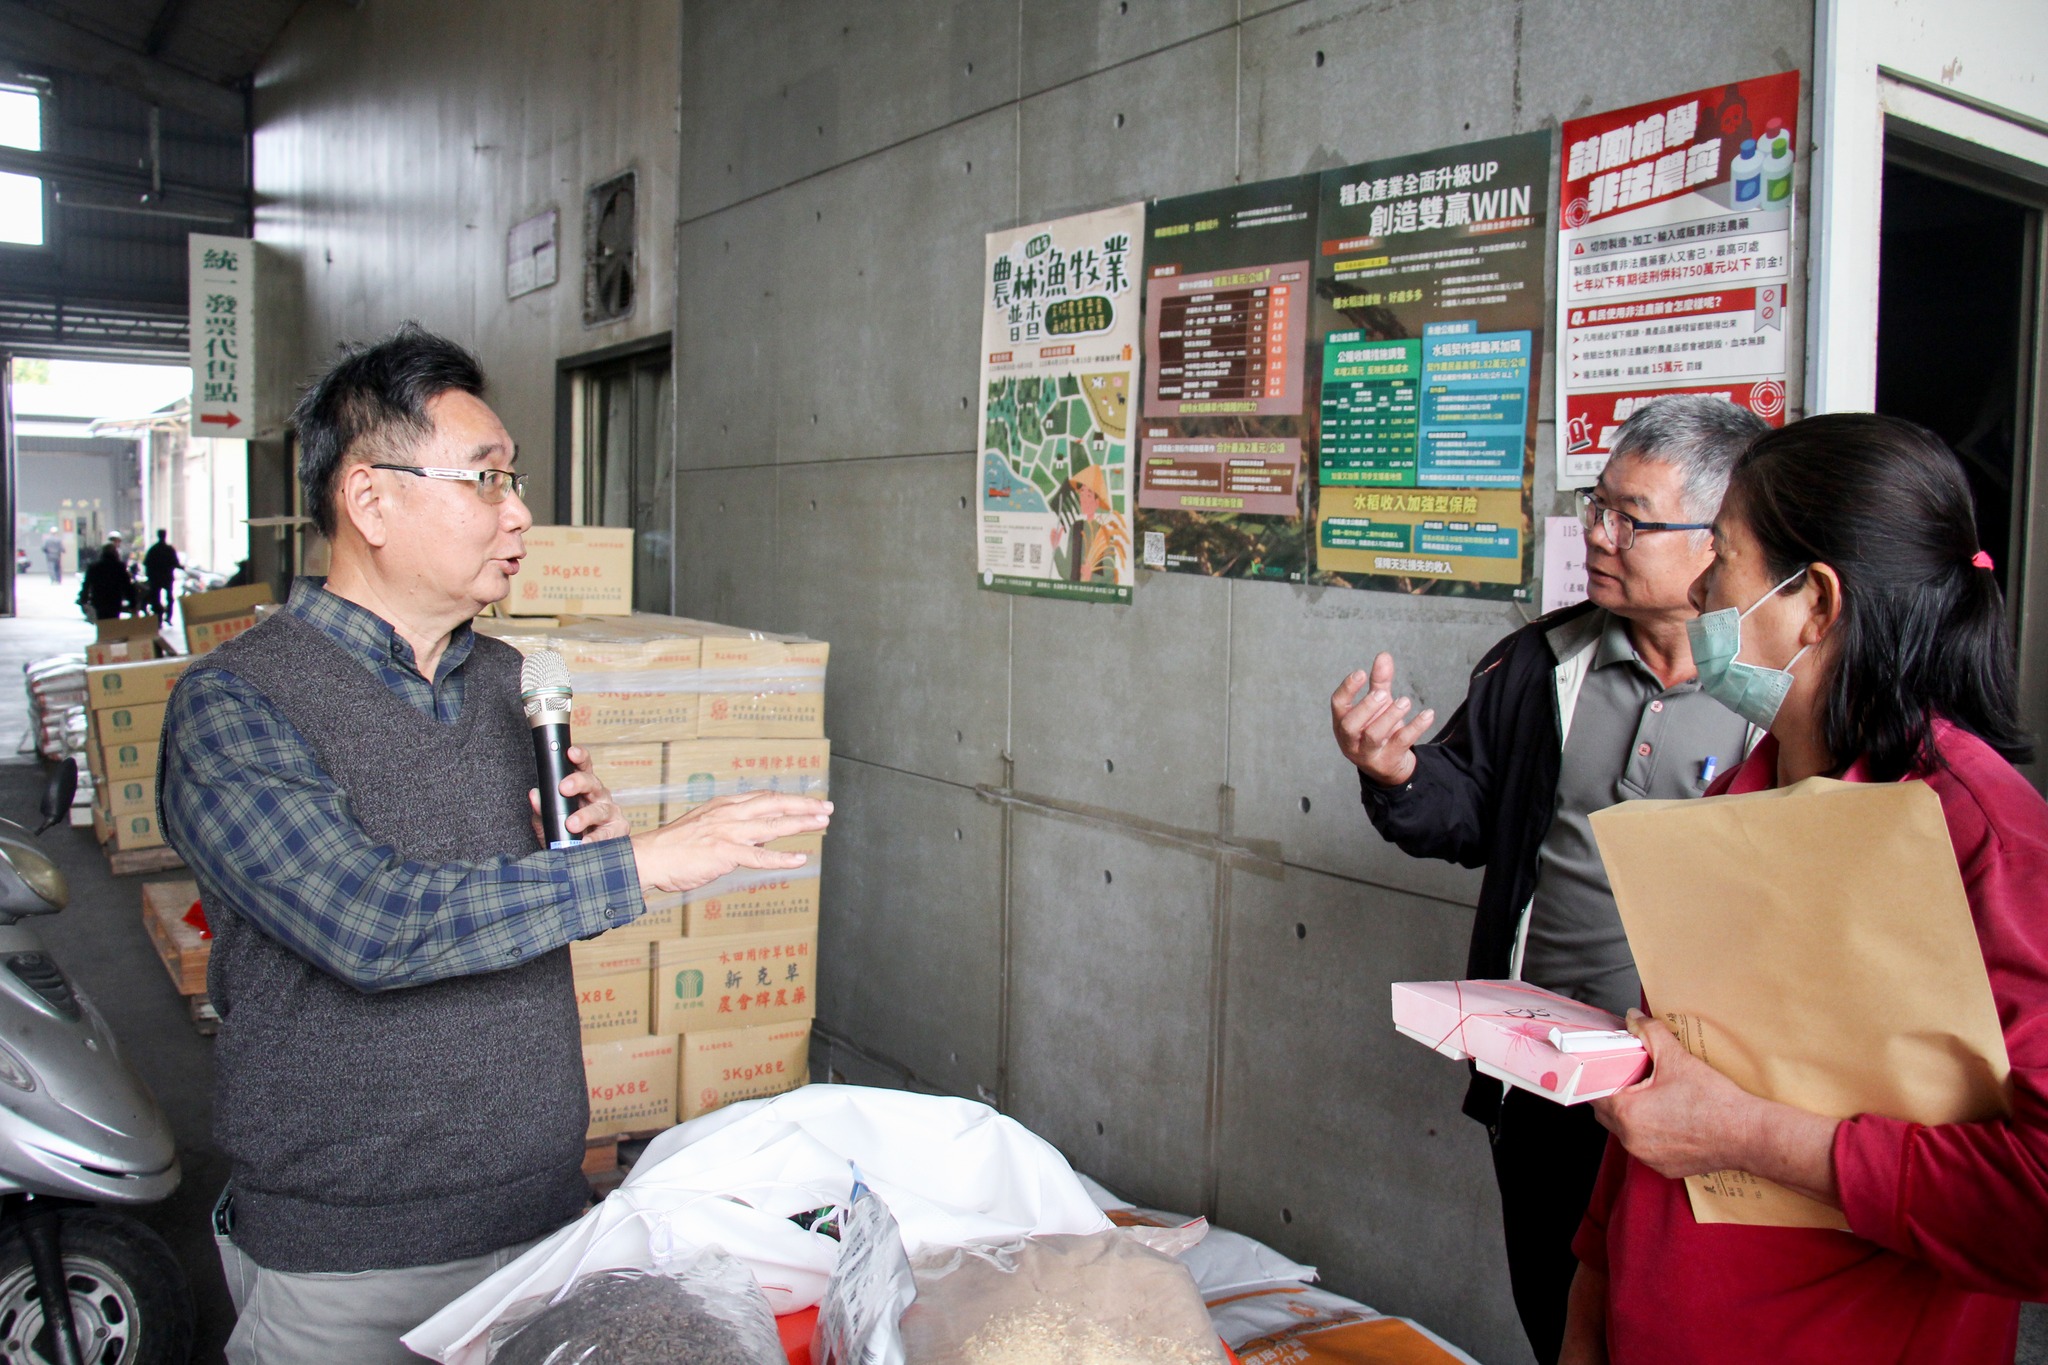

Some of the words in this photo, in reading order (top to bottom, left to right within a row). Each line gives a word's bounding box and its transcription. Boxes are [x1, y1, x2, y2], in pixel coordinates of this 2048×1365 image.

[1340, 161, 1498, 206] 糧食產業全面升級UP
[1588, 138, 1721, 217] 非法農藥
[1369, 186, 1531, 237] 創造雙贏WIN
[993, 234, 1128, 309] 農林漁牧業
[1008, 301, 1041, 342] 普查
[1652, 361, 1683, 374] 15萬元
[1353, 494, 1478, 514] 水稻收入加強型保險
[725, 963, 799, 989] 新克草
[718, 986, 807, 1013] 農會牌農藥
